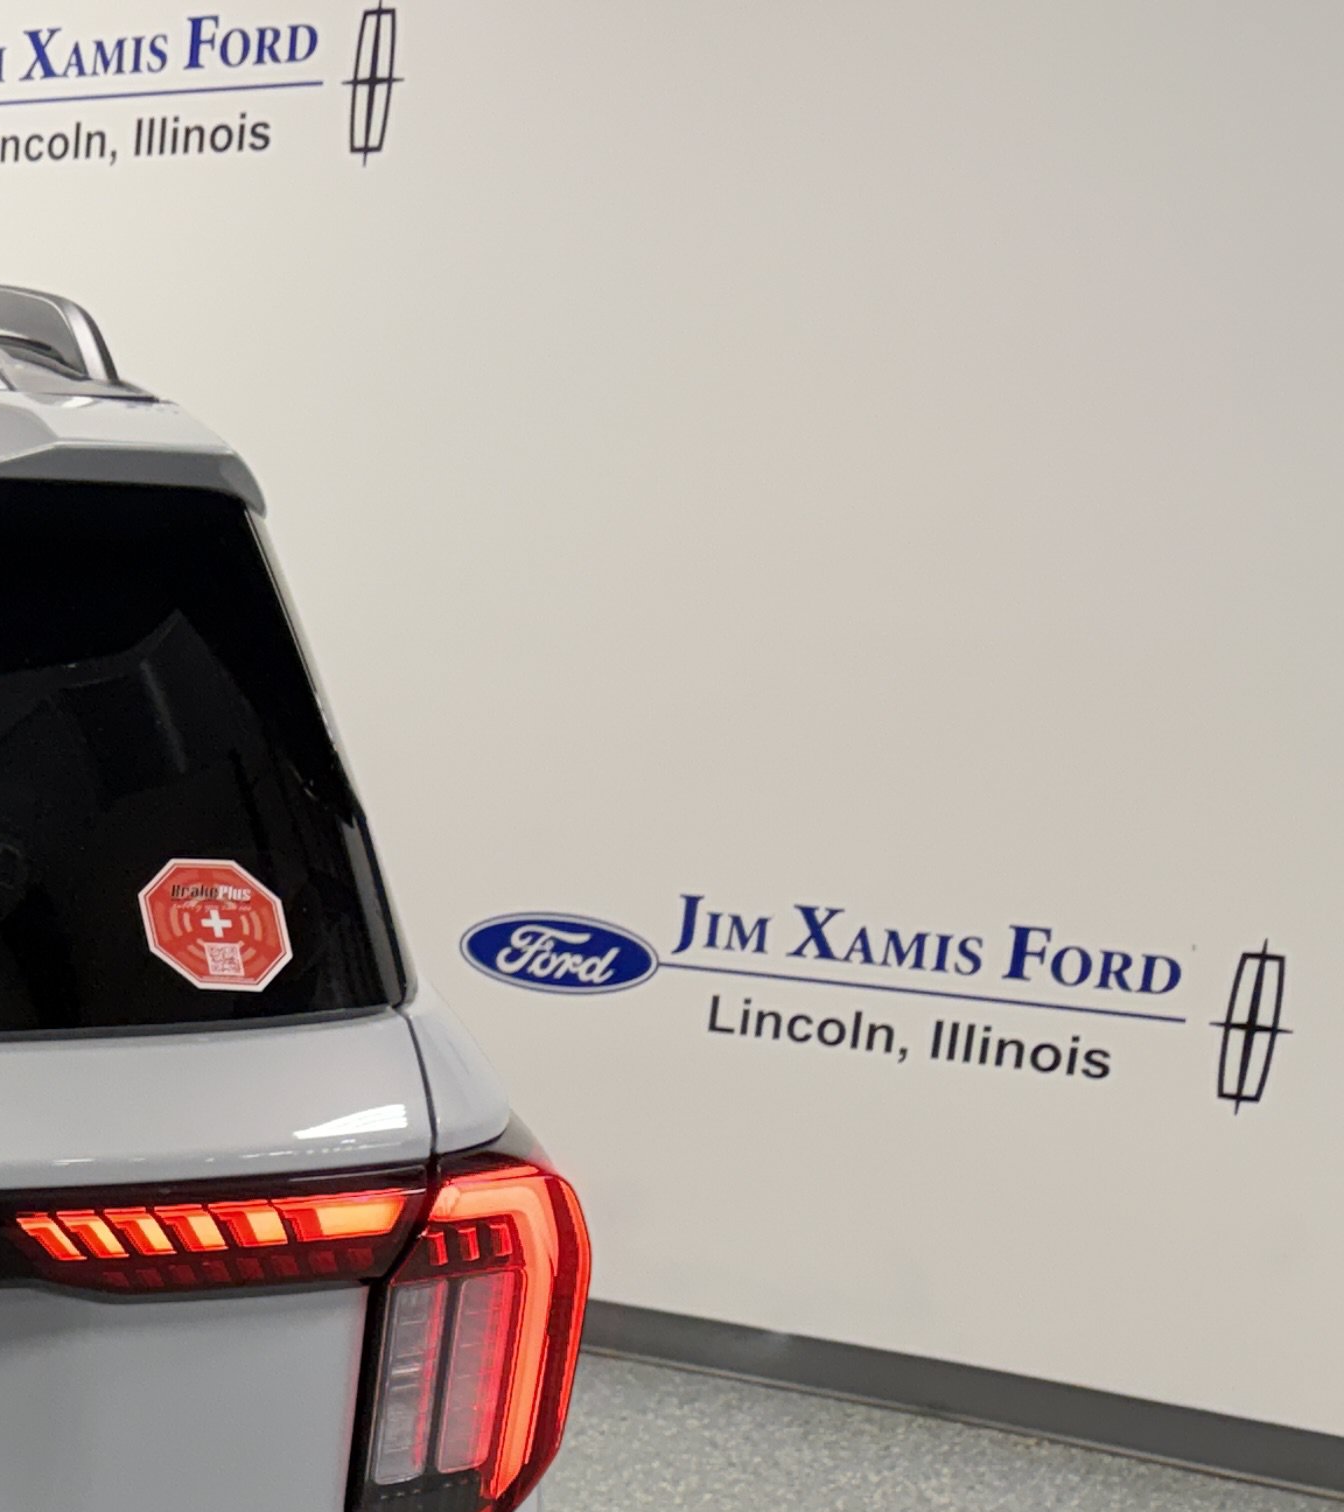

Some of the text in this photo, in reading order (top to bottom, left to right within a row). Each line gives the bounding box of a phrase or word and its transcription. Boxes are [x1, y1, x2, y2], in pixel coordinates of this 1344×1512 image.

[19, 27, 169, 81] XAMIS
[183, 15, 320, 71] FORD
[134, 114, 271, 157] Illinois
[495, 925, 613, 984] Ford
[671, 894, 1182, 995] JIM XAMIS FORD
[707, 995, 1112, 1080] Lincoln, Illinois
